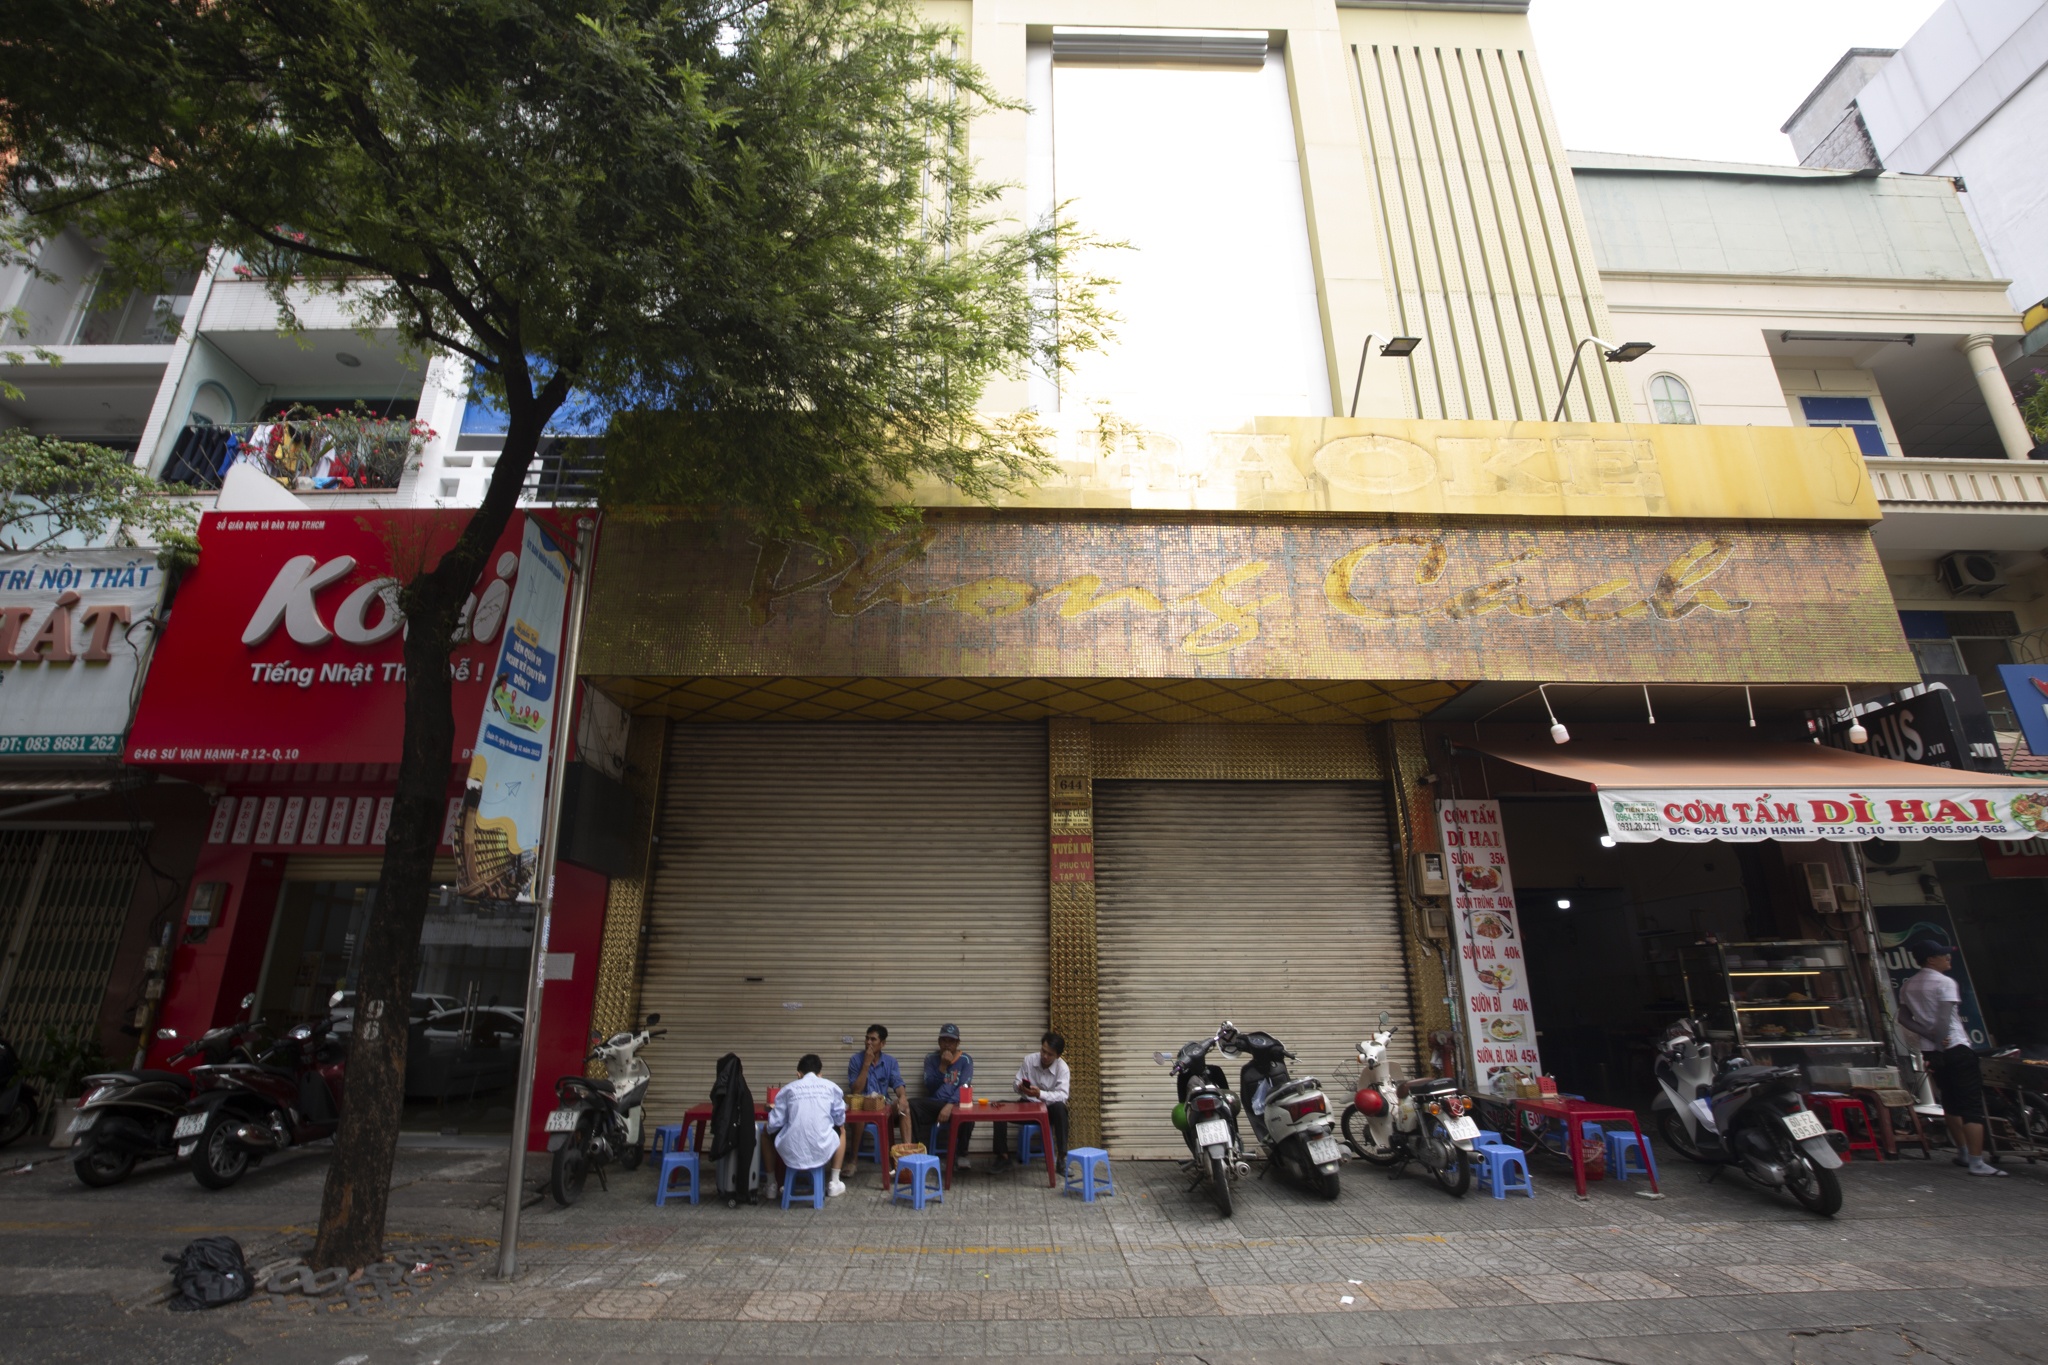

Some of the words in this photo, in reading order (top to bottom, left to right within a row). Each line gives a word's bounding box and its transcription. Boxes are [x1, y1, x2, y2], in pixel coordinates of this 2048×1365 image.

[39, 563, 82, 593] NỘI
[91, 558, 154, 588] THẤT
[250, 660, 316, 688] Tiếng
[319, 661, 374, 687] Nhật
[25, 736, 51, 751] 083
[53, 736, 85, 750] 8681
[90, 735, 117, 750] 262
[134, 748, 156, 760] 646
[180, 748, 201, 762] VẠN
[285, 748, 299, 760] 10
[1060, 779, 1082, 790] 644
[1663, 798, 1728, 824] CƠM
[1732, 794, 1801, 824] TẤM
[1807, 793, 1879, 824] DÌ
[1888, 798, 2003, 824] HAI
[1447, 825, 1465, 847] DÌ
[1469, 830, 1500, 847] HAI
[1669, 826, 1691, 836] ĐC:
[1694, 827, 1718, 836] 642
[1741, 826, 1767, 837] VẠN
[1771, 826, 1806, 837] HẠNH
[1817, 826, 1846, 835] P.12
[1857, 825, 1885, 836] Q.10
[1898, 825, 1919, 835] ĐT:
[1923, 824, 2007, 835] 0905.904.568
[1052, 838, 1078, 855] TUYỂN
[1081, 843, 1092, 855] NV
[1059, 861, 1078, 870] PHỤC
[1489, 852, 1506, 865] 35k
[1497, 896, 1514, 909] 40k
[1504, 946, 1521, 959] 40k
[1471, 992, 1492, 1013] SƯỜN
[1512, 998, 1529, 1012] 40k
[1521, 1049, 1538, 1063] 45k
